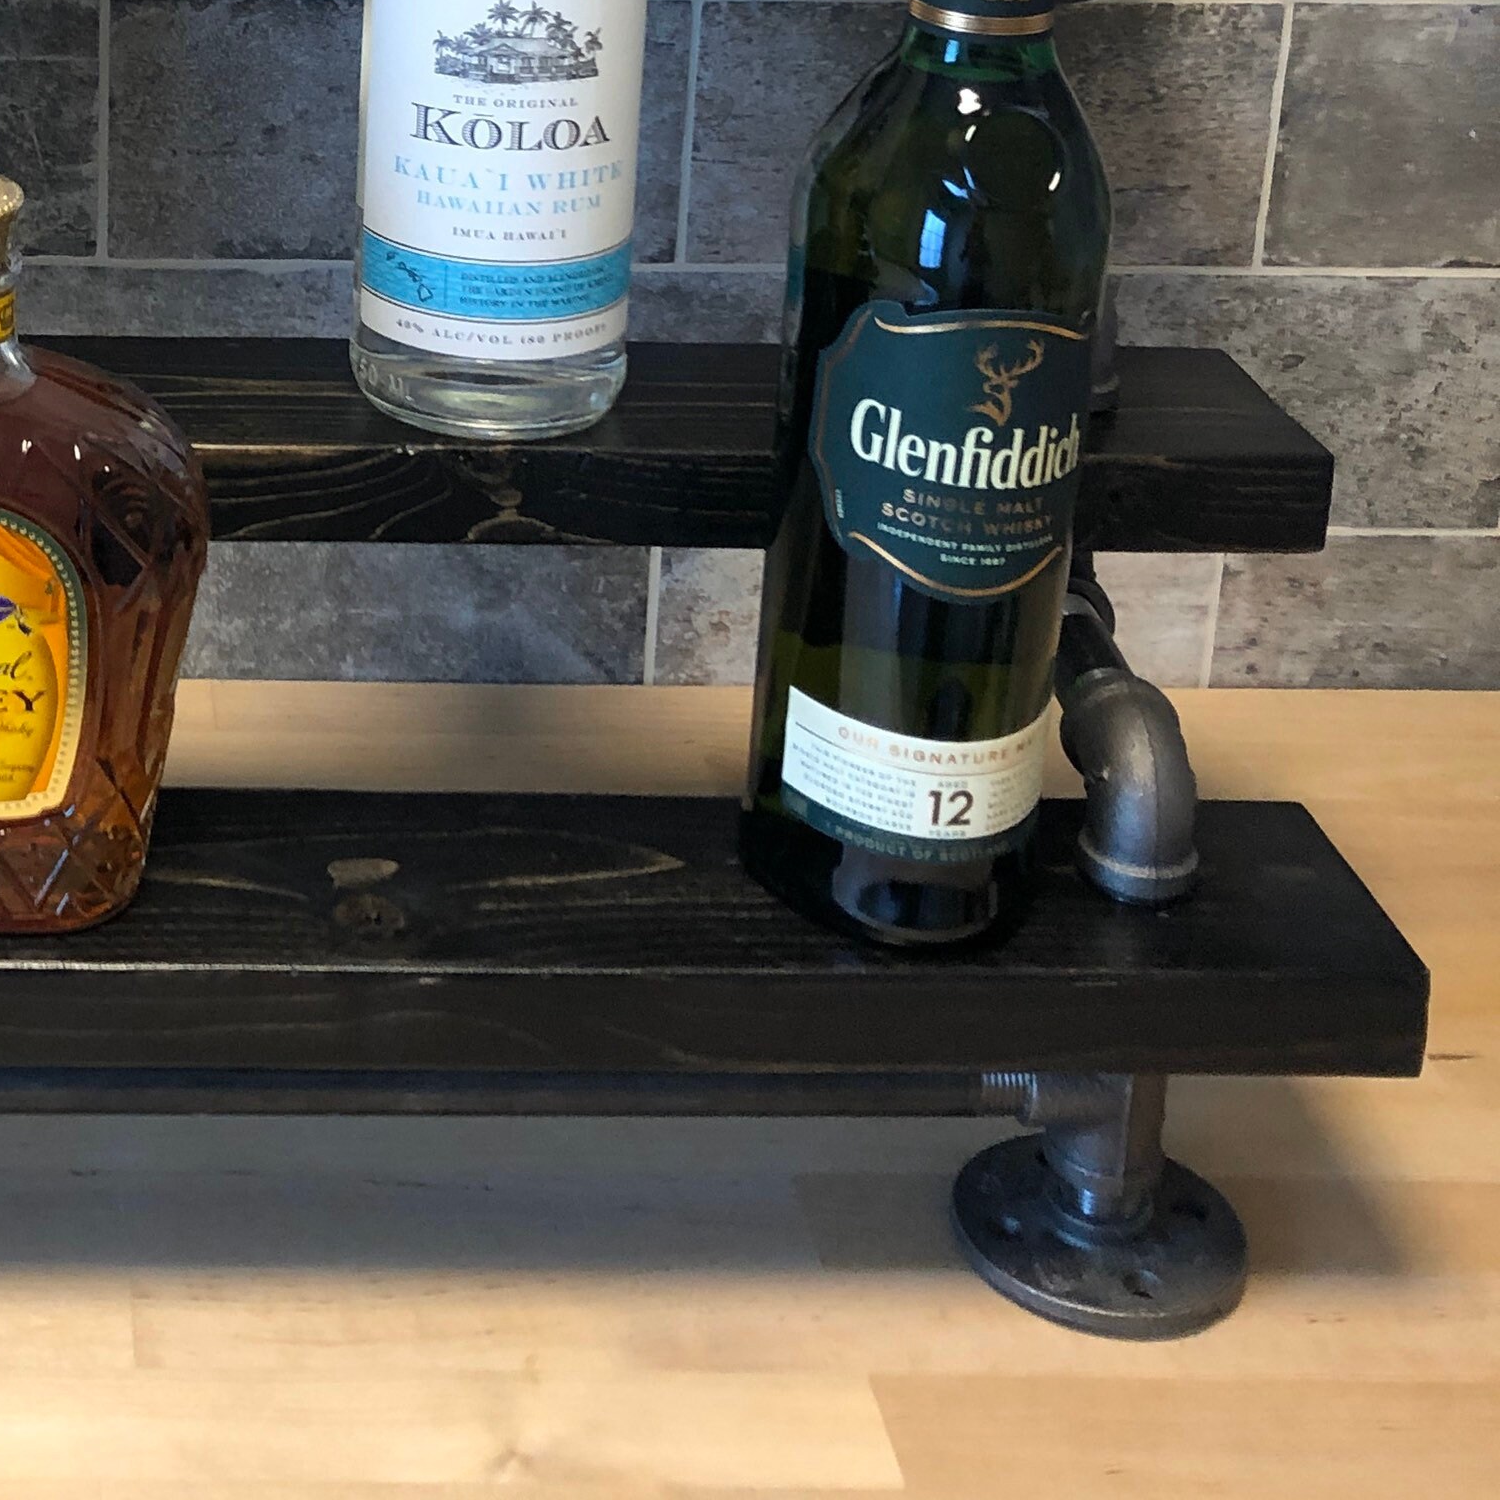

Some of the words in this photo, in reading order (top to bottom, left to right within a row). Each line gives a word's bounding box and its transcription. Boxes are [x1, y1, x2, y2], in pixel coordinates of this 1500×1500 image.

[453, 94, 487, 107] THE
[493, 97, 579, 109] ORIGINAL
[527, 160, 623, 191] WHITE
[417, 189, 542, 216] HAWAIIAN
[552, 194, 601, 214] RUM
[452, 226, 495, 241] IMUA
[902, 488, 985, 515] SINGLE
[996, 497, 1044, 514] MALT
[881, 502, 972, 535] SCOTCH
[877, 521, 957, 550] INDEPENDENT
[961, 542, 1001, 552] FAMILY
[940, 553, 976, 566] SINCE
[838, 726, 880, 750] OUR
[889, 742, 1008, 765] SIGNATURE
[929, 789, 974, 827] 12
